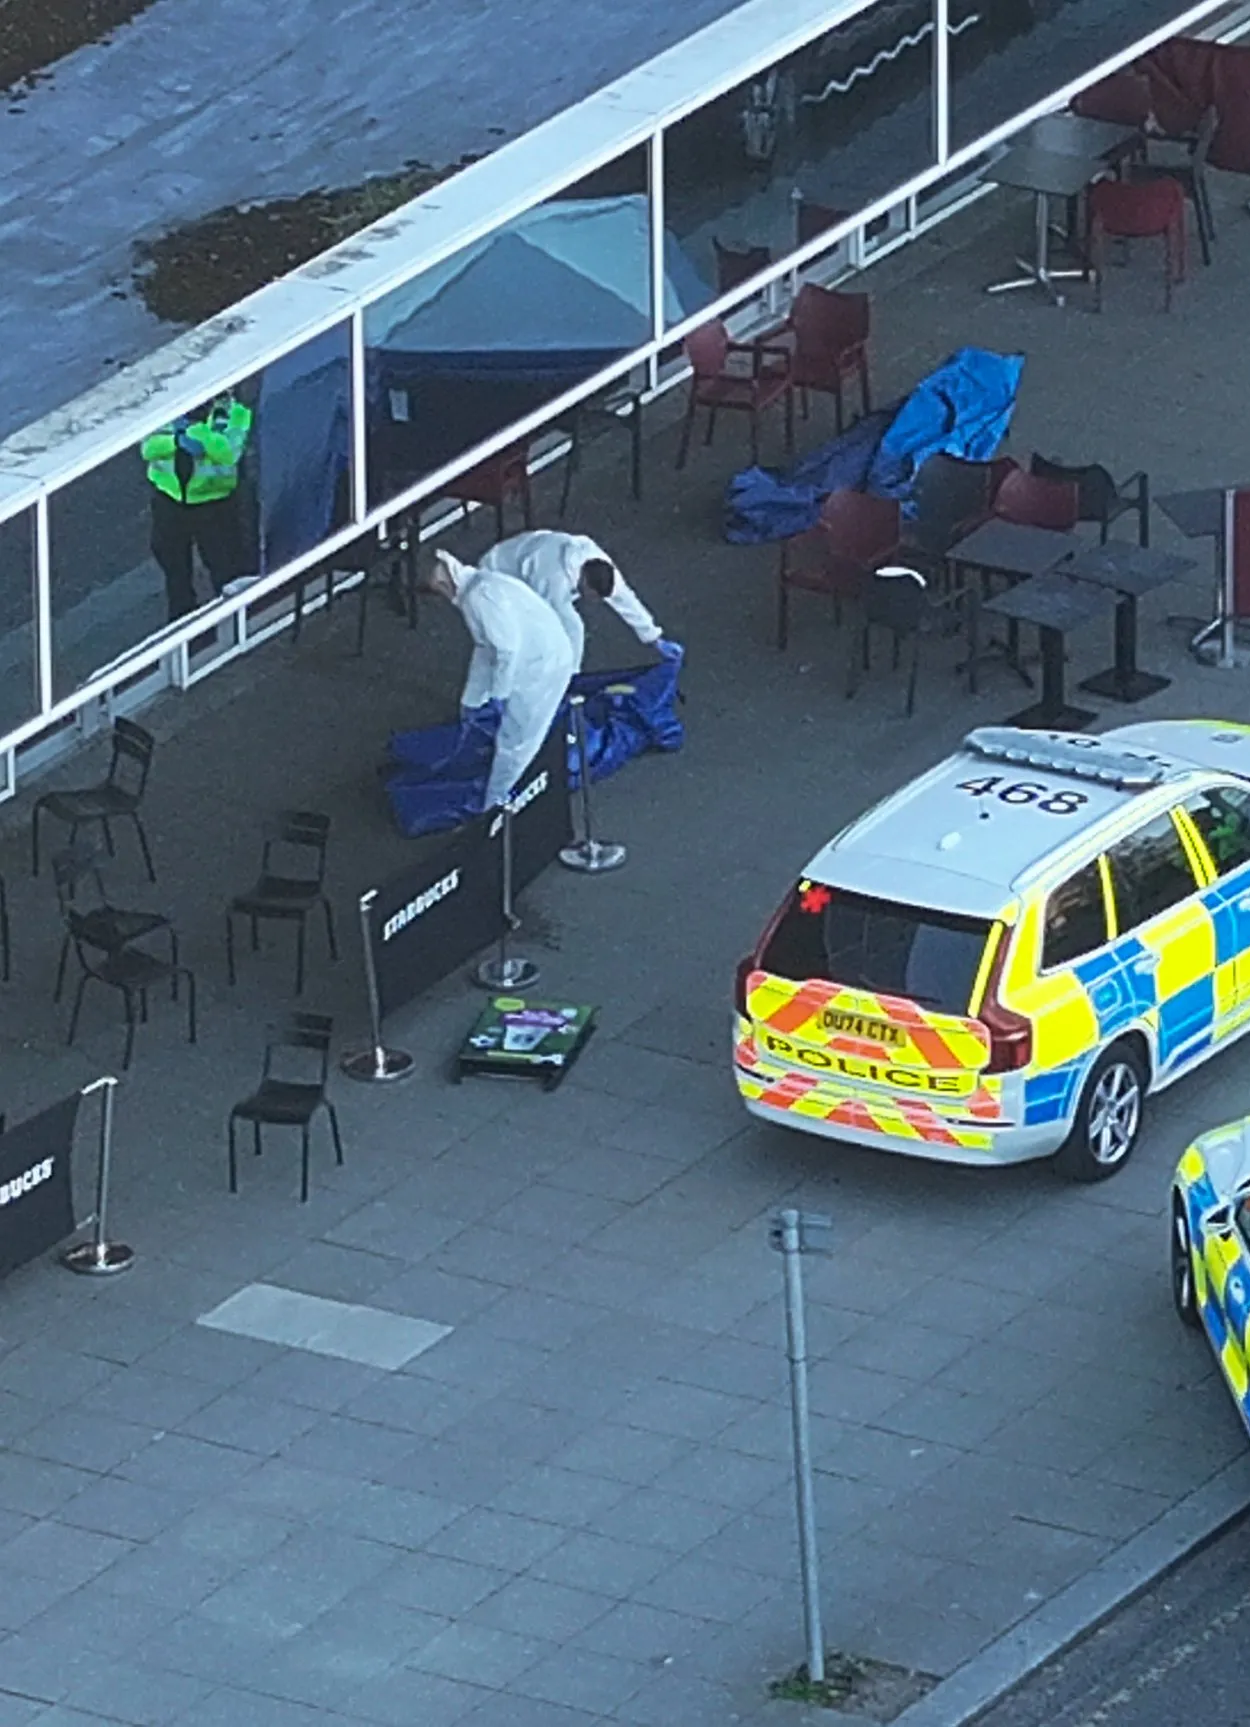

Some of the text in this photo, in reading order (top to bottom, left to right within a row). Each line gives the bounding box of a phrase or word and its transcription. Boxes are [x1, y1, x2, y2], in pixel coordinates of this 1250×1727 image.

[956, 775, 1089, 815] 468
[383, 867, 460, 941] STARBUCKS
[766, 1035, 960, 1093] POLICE
